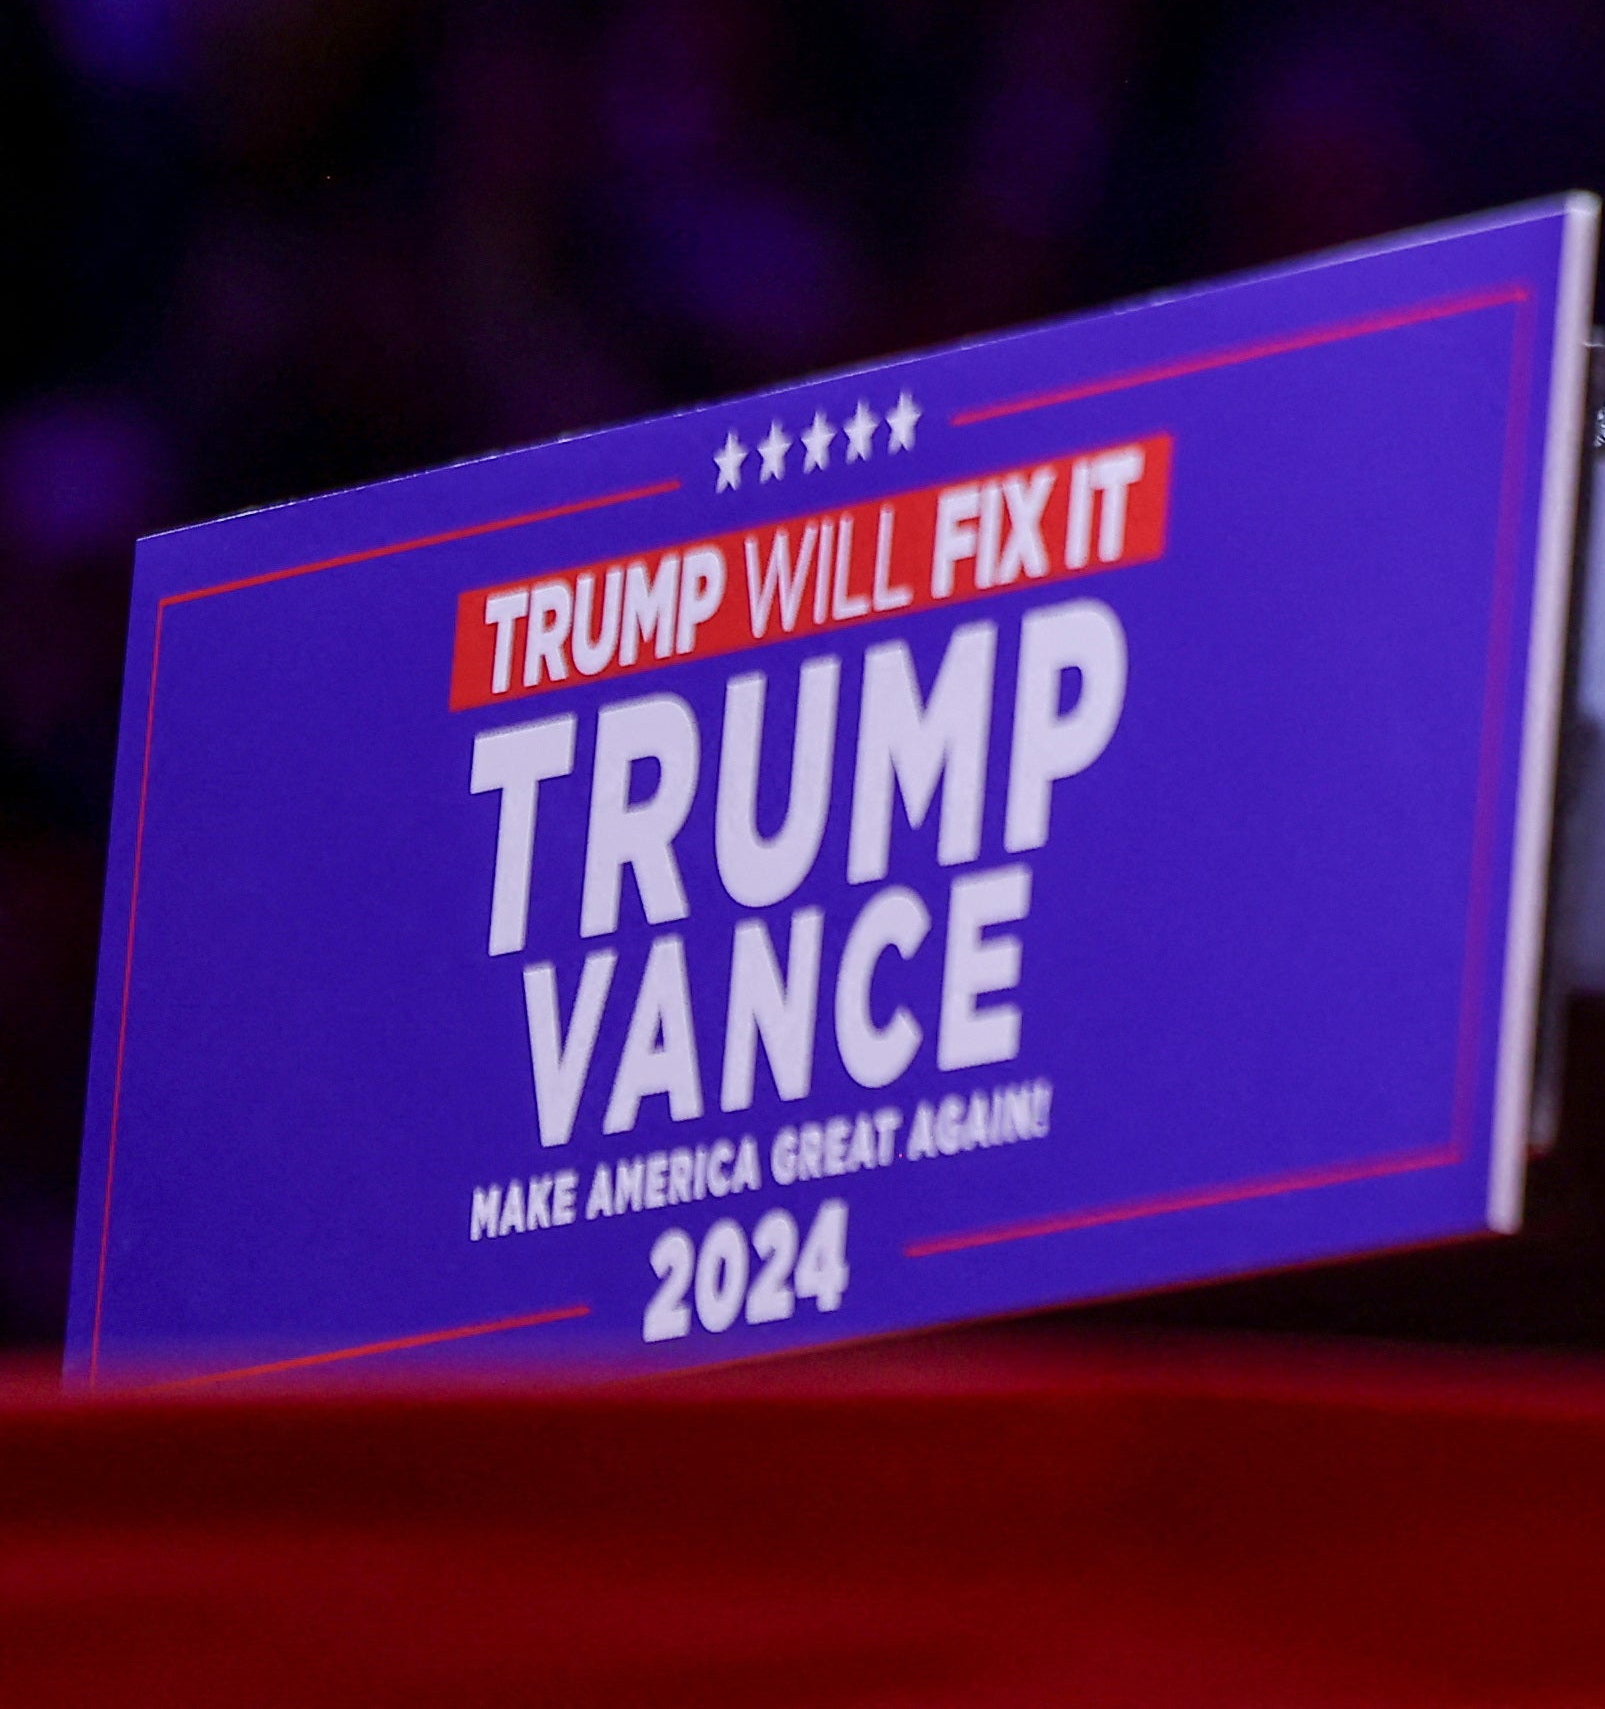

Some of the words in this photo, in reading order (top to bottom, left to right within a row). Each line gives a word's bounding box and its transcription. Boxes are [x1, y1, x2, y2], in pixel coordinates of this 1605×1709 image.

[485, 546, 727, 694] TRUMP
[744, 505, 914, 639] WILL
[931, 466, 1057, 599] FIX
[1065, 446, 1145, 570] IT
[470, 599, 1129, 956] TRUMP
[522, 864, 1032, 1148] VANCE
[470, 1170, 578, 1241] MAKE
[586, 1137, 761, 1220] AMERICA
[772, 1108, 901, 1185] GREAT
[908, 1077, 1054, 1161] AGAIN!
[643, 1199, 849, 1343] 2024
